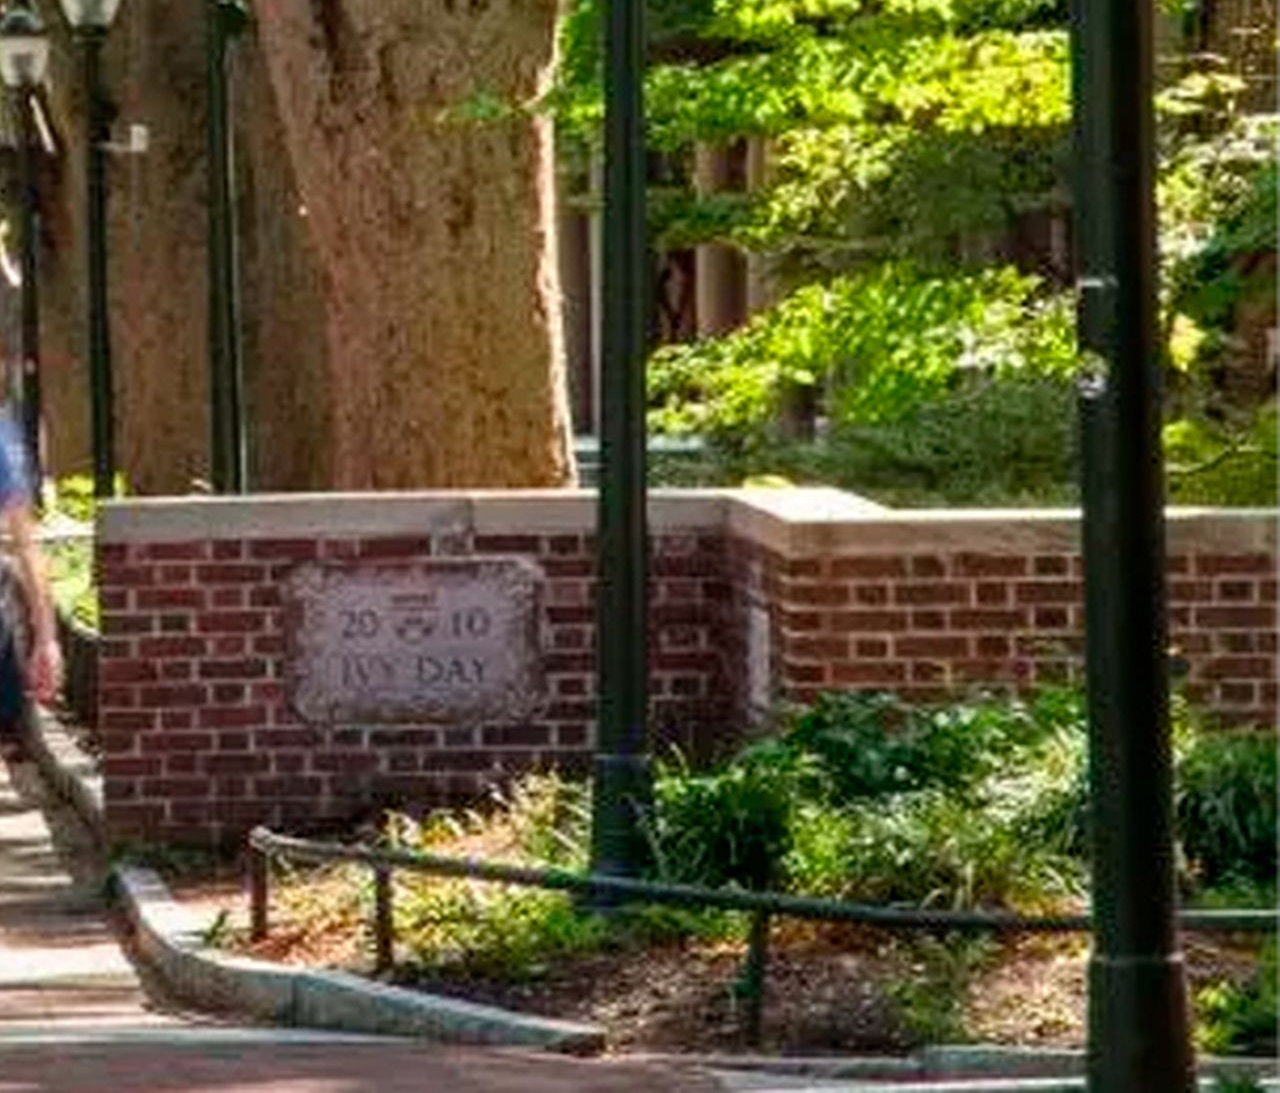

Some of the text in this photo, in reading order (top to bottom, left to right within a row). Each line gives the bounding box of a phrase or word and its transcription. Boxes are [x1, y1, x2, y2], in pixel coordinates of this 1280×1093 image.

[339, 608, 490, 638] 20 10
[342, 654, 484, 686] IVY DAY
